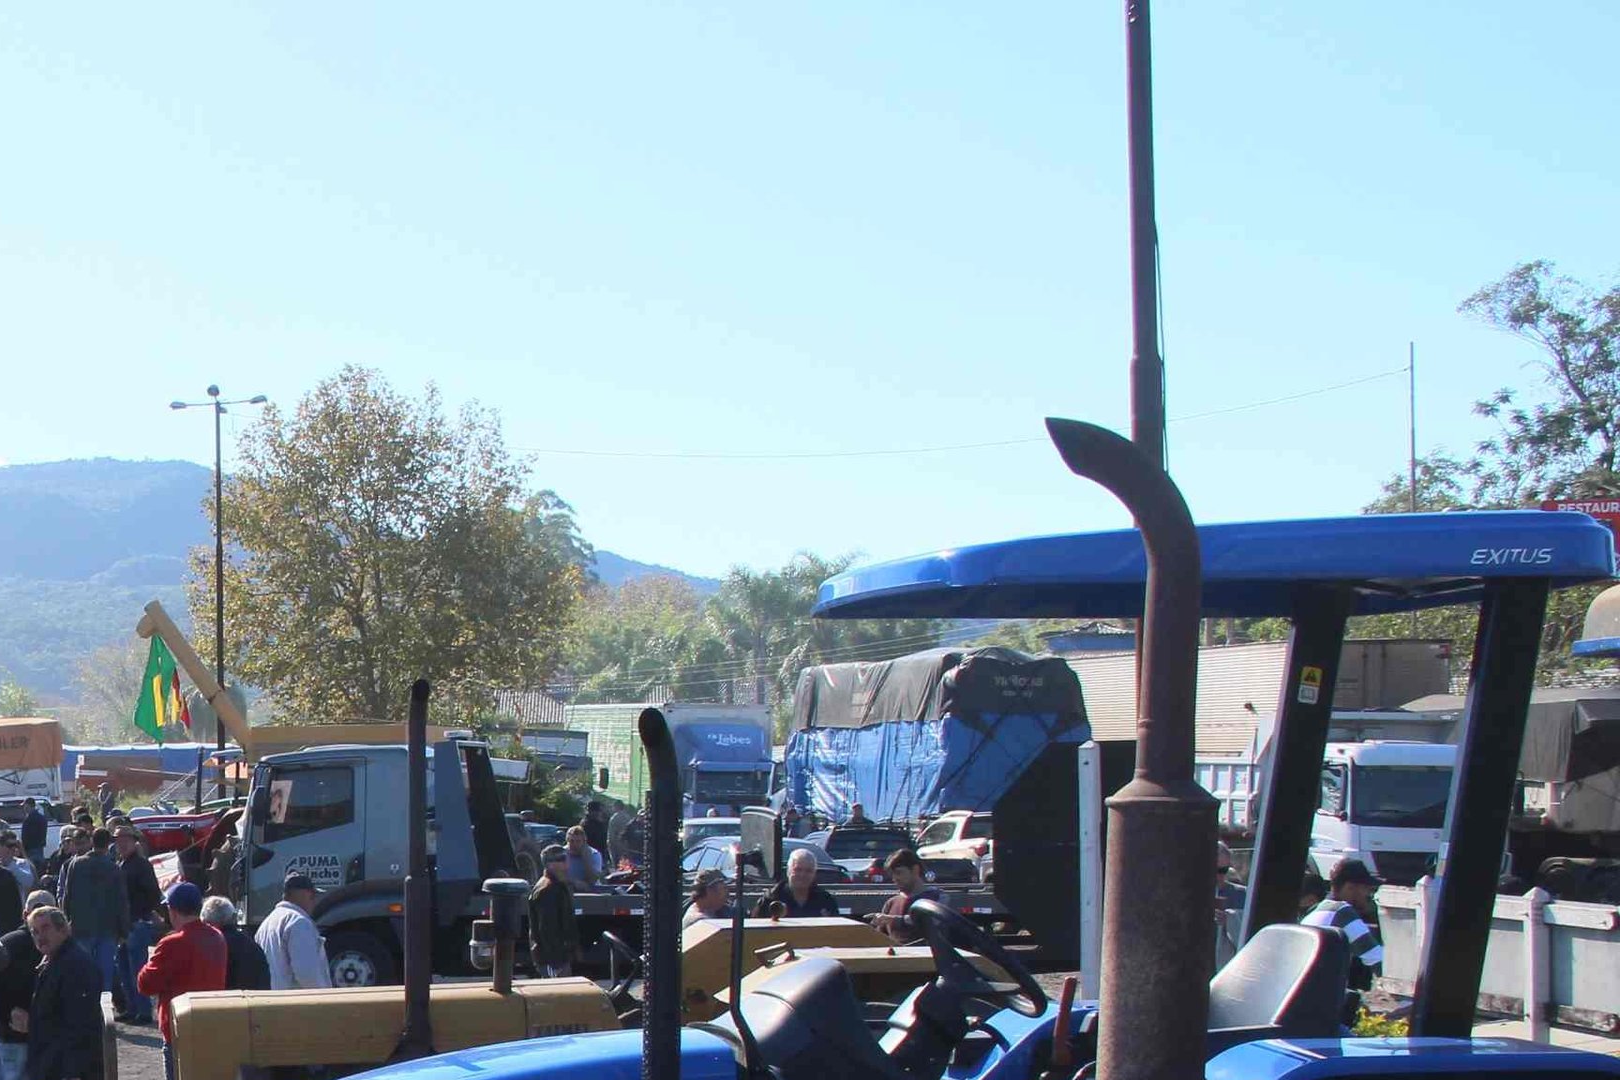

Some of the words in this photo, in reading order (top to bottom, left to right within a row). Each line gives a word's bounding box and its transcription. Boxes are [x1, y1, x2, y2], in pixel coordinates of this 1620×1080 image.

[1558, 502, 1620, 513] RESTAUR
[1470, 547, 1556, 565] EXITUS
[299, 855, 339, 867] PUMA
